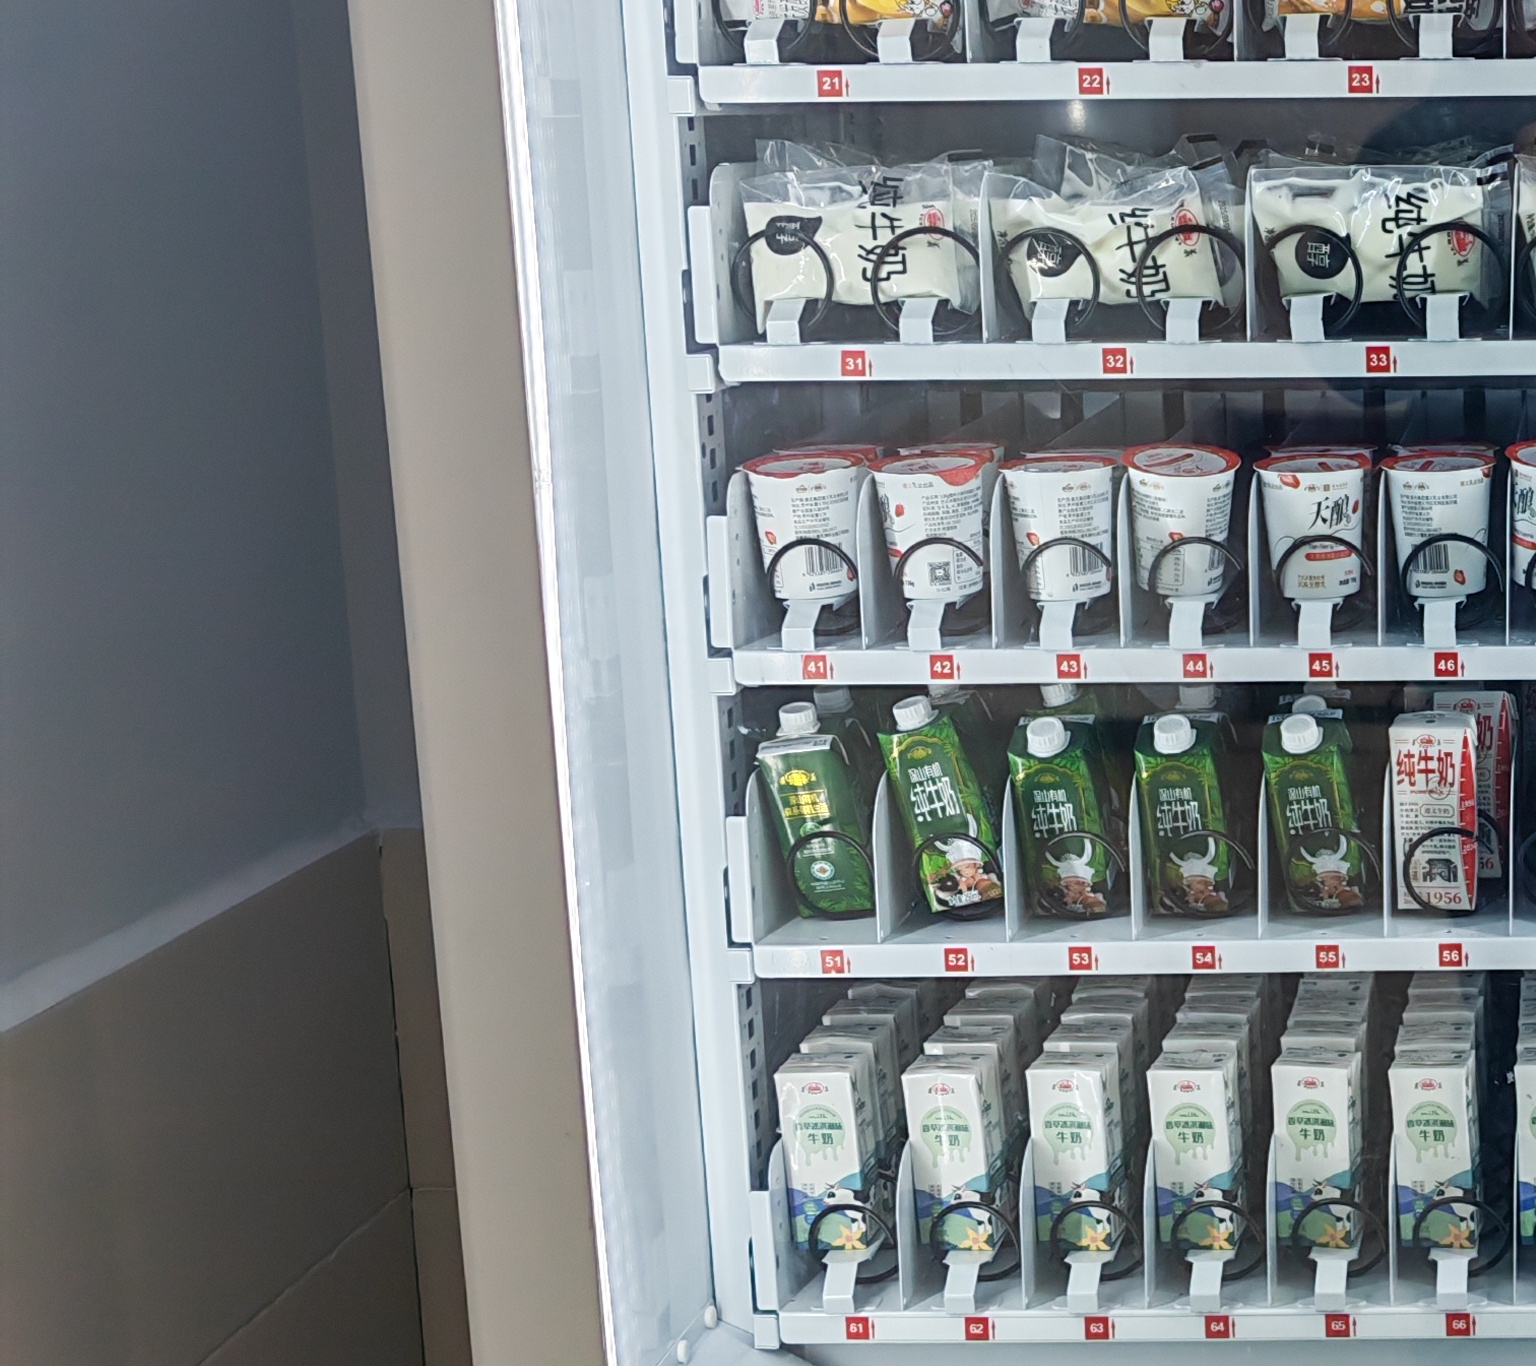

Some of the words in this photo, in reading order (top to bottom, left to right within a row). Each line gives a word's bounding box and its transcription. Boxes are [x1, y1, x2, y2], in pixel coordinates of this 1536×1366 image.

[822, 76, 840, 90] 21
[1082, 74, 1101, 88] 22
[1351, 73, 1370, 87] 23
[845, 357, 863, 371] 31
[1106, 354, 1124, 368] 32
[1369, 353, 1388, 367] 33
[807, 660, 824, 673] 41
[933, 660, 952, 674] 42
[1059, 660, 1078, 673] 43
[1185, 660, 1205, 673] 44
[1311, 660, 1331, 672] 45
[1437, 659, 1455, 671] 46
[1396, 748, 1456, 788] 纯牛奶
[910, 776, 961, 822] 纯牛奶
[1031, 801, 1078, 838] 纯牛奶
[1156, 800, 1202, 837] 纯牛奶
[1285, 798, 1332, 835] 纯牛奶
[825, 955, 841, 968] 51
[948, 953, 966, 966] 52
[1072, 952, 1090, 965] 53
[1195, 952, 1213, 964] 54
[1319, 951, 1337, 963] 55
[1442, 950, 1460, 962] 56
[807, 1132, 834, 1146] 牛奶
[934, 1133, 961, 1147] 牛奶
[1055, 1131, 1082, 1145] 牛奶
[1177, 1130, 1205, 1145] 牛奶
[1299, 1128, 1326, 1142] 牛奶
[1418, 1129, 1445, 1143] 牛奶
[849, 1322, 863, 1333] 61
[969, 1323, 984, 1334] 62
[1089, 1322, 1104, 1334] 63
[1210, 1321, 1225, 1332] 64
[1331, 1320, 1346, 1331] 65
[1452, 1319, 1467, 1330] 66
